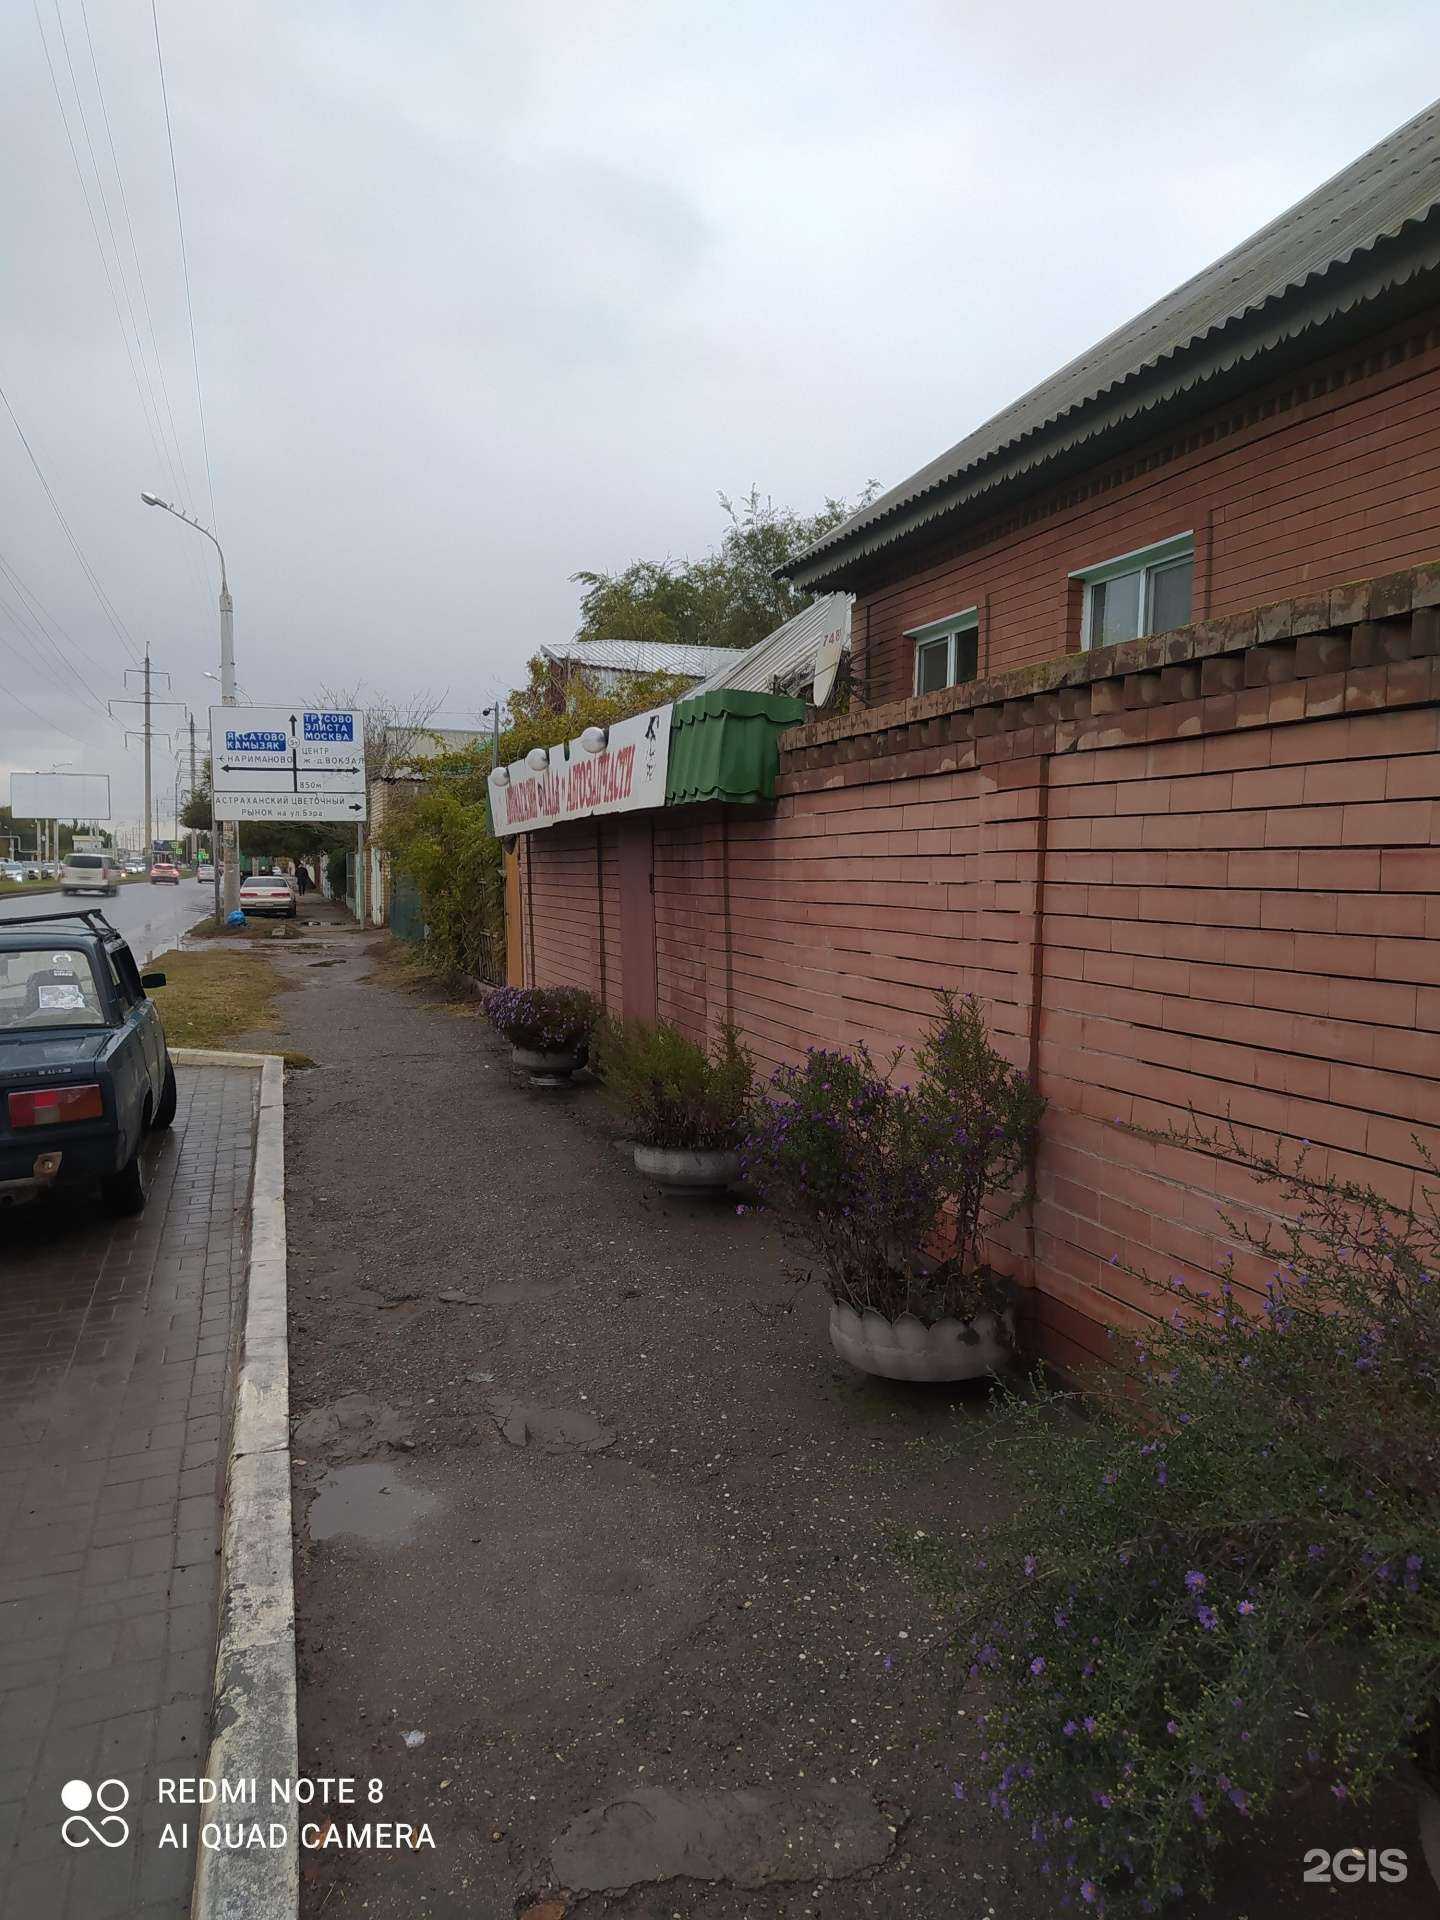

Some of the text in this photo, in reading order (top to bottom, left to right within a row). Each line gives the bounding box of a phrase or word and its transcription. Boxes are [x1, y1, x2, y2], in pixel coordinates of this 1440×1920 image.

[304, 714, 352, 723] ТРУСОВО
[304, 723, 348, 732] ЭЛИСТА
[227, 732, 285, 741] ЯКСАТОВО
[305, 732, 350, 741] МОСКВА
[227, 741, 280, 750] КАМЫЗЯК
[302, 747, 328, 755] ЦЕНТР
[227, 755, 293, 763] НАРИМАНОВО
[566, 743, 636, 812] АВТОЗАПЧАСТИ
[215, 795, 345, 806] АСТРАХАНСКИЙ ЦВЕТОЧНЫЙ
